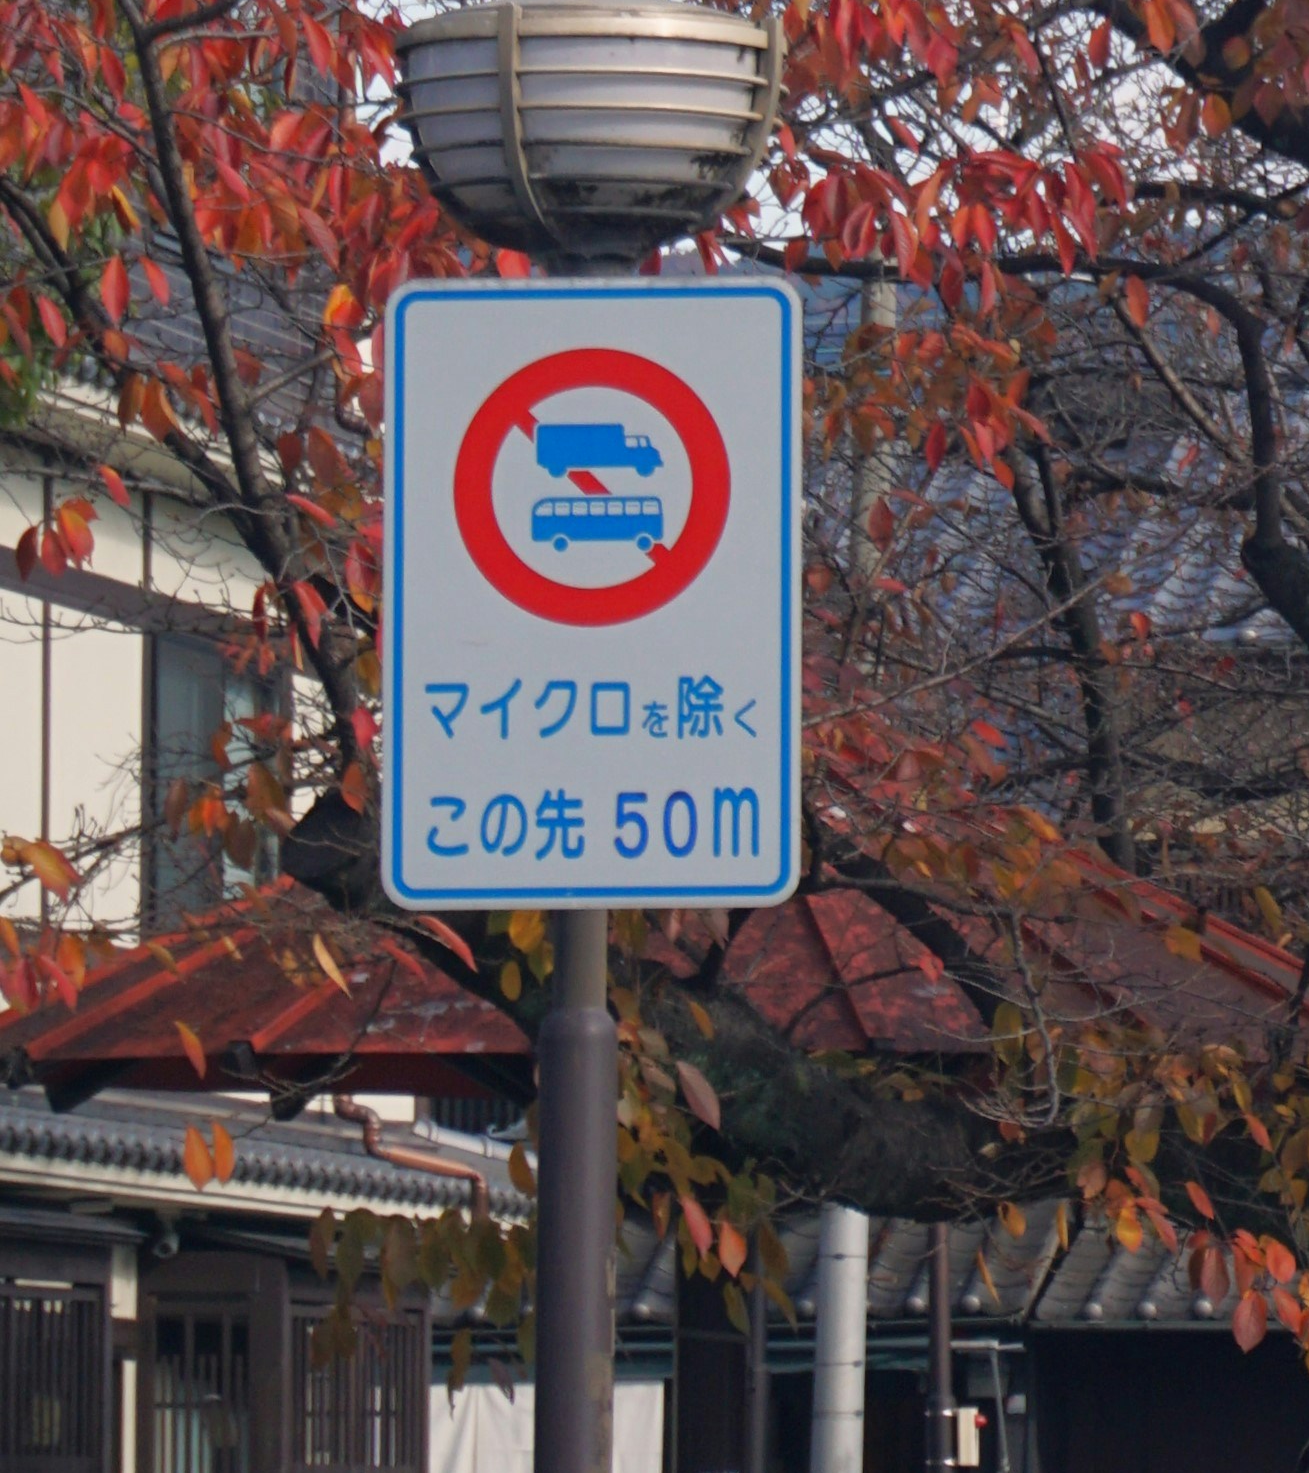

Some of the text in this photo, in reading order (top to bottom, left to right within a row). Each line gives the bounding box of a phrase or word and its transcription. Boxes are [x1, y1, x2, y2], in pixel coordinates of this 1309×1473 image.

[424, 676, 758, 740] マイクロを除く
[426, 786, 761, 860] この先 50m
